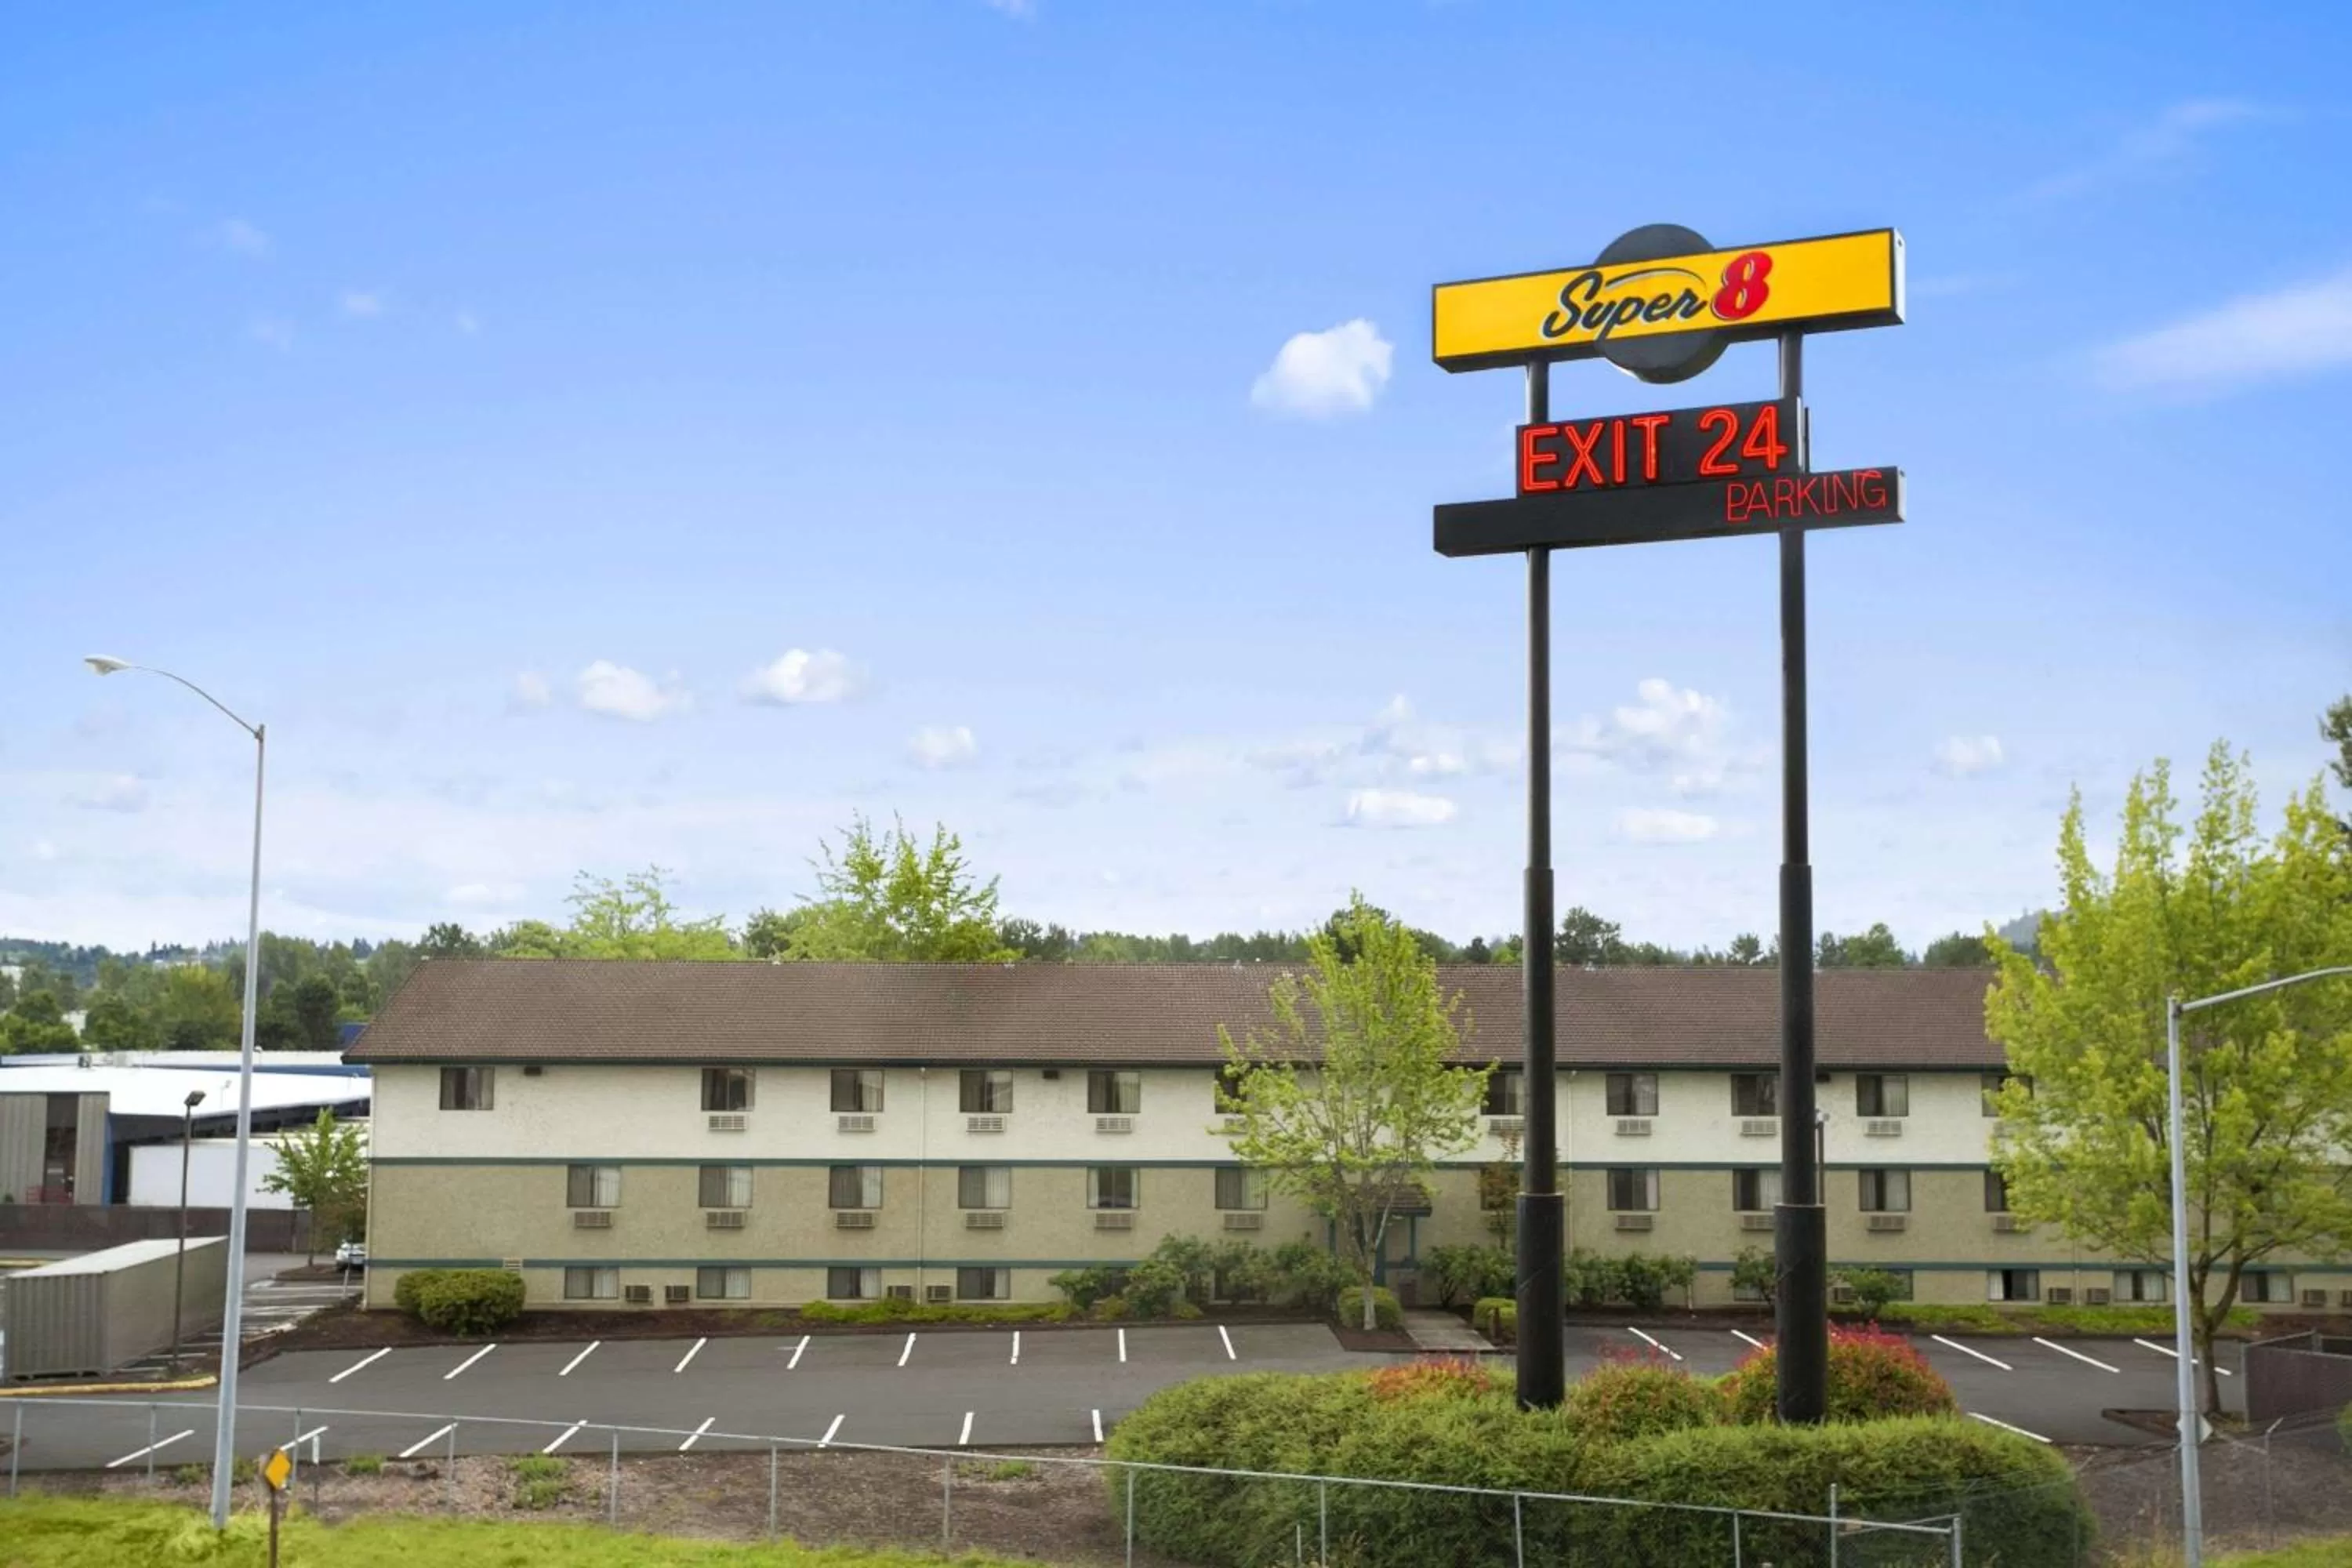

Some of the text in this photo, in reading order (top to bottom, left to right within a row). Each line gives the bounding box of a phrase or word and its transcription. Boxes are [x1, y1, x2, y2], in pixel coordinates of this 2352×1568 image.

[1541, 252, 1772, 341] Super 8
[1522, 406, 1788, 492] EXIT 24
[1727, 470, 1886, 521] PARKING
